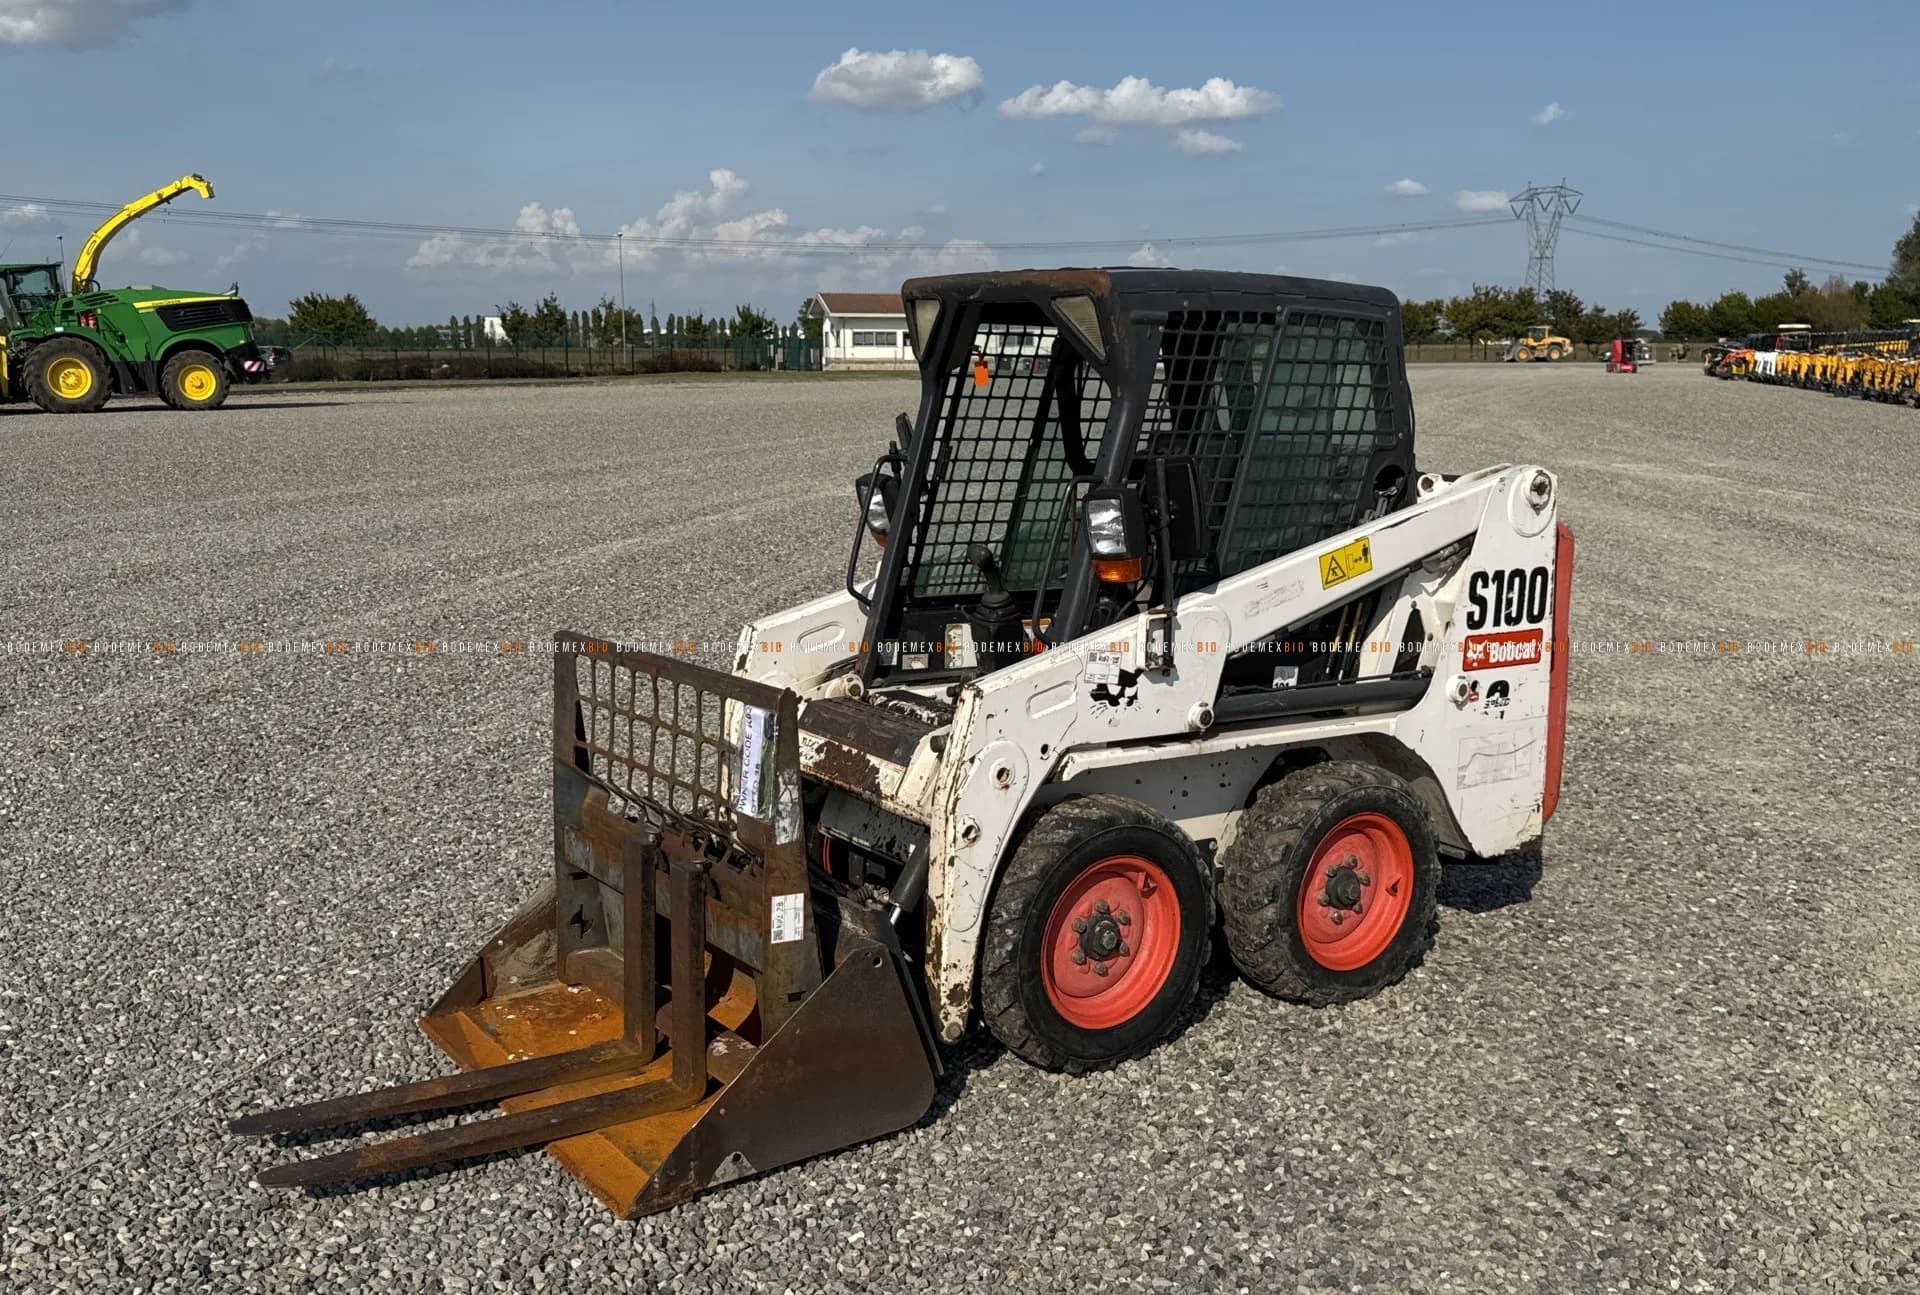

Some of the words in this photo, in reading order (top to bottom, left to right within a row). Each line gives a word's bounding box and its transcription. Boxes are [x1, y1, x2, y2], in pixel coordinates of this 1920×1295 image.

[1466, 566, 1549, 630] S100
[1488, 639, 1537, 663] Bobcat
[744, 733, 752, 767] CODE
